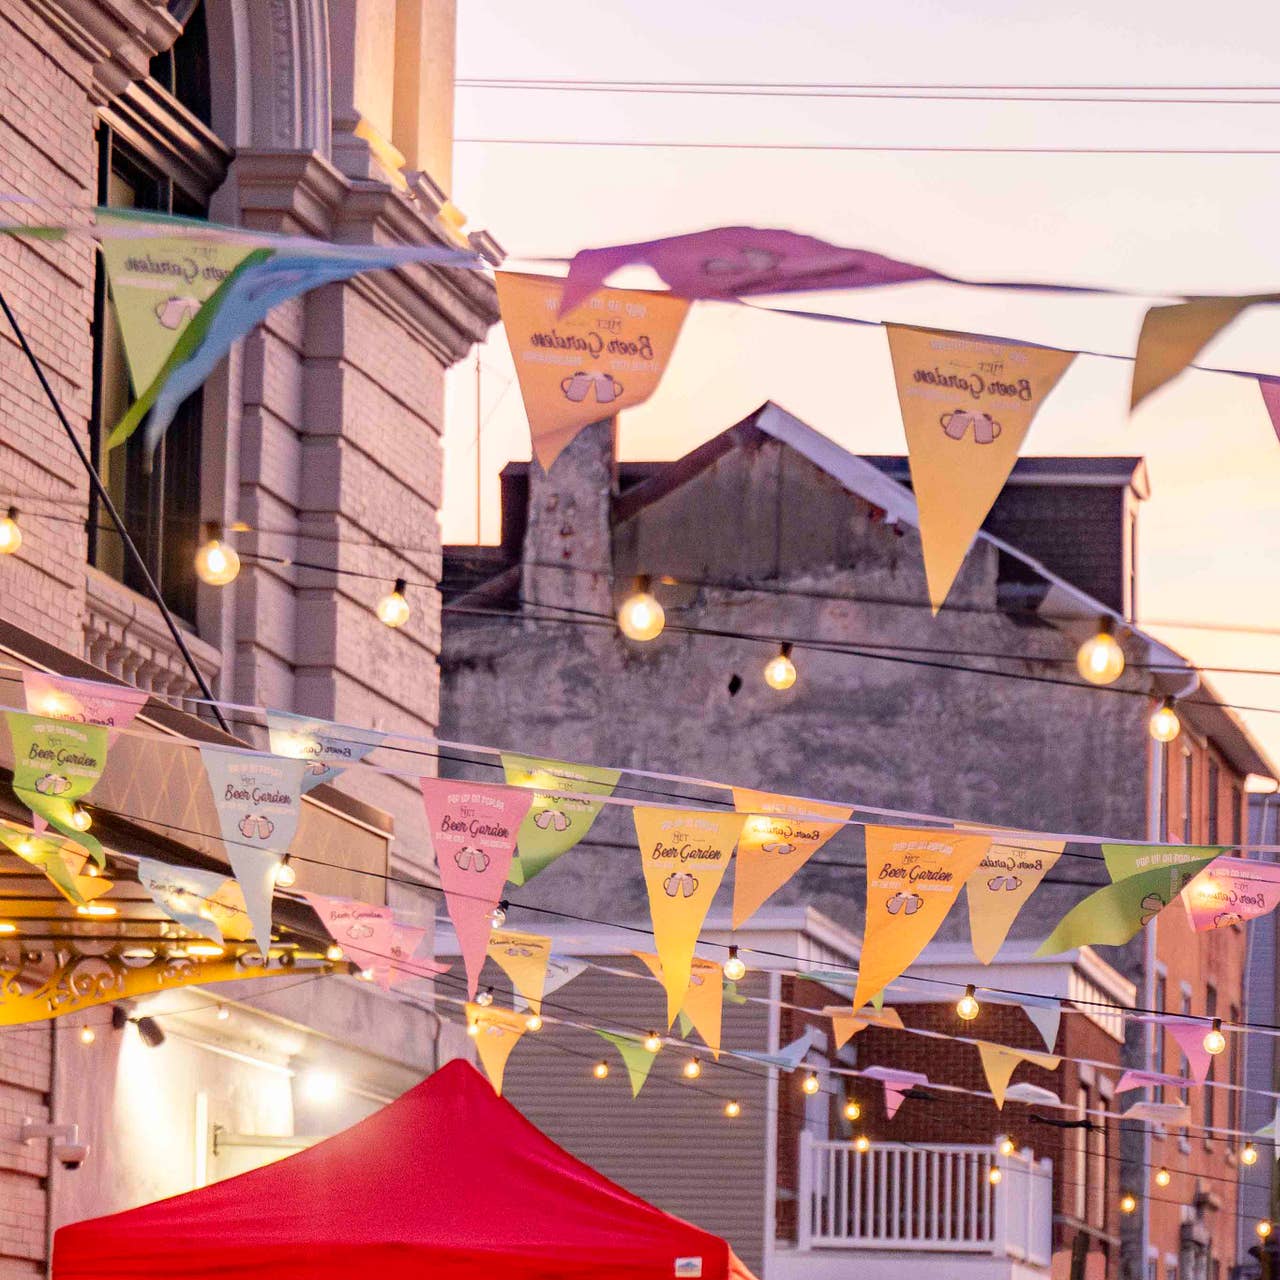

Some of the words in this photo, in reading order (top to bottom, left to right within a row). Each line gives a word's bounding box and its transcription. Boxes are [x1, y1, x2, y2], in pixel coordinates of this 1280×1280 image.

[28, 743, 56, 761] Beer
[56, 748, 97, 768] Garden
[225, 784, 252, 801] Beer
[252, 787, 292, 806] Garden
[441, 815, 468, 832] Beer
[468, 819, 510, 838] Garden
[652, 842, 679, 860] Beer
[679, 844, 722, 863] Garden
[878, 863, 907, 880] Beer
[909, 865, 953, 884] Garden
